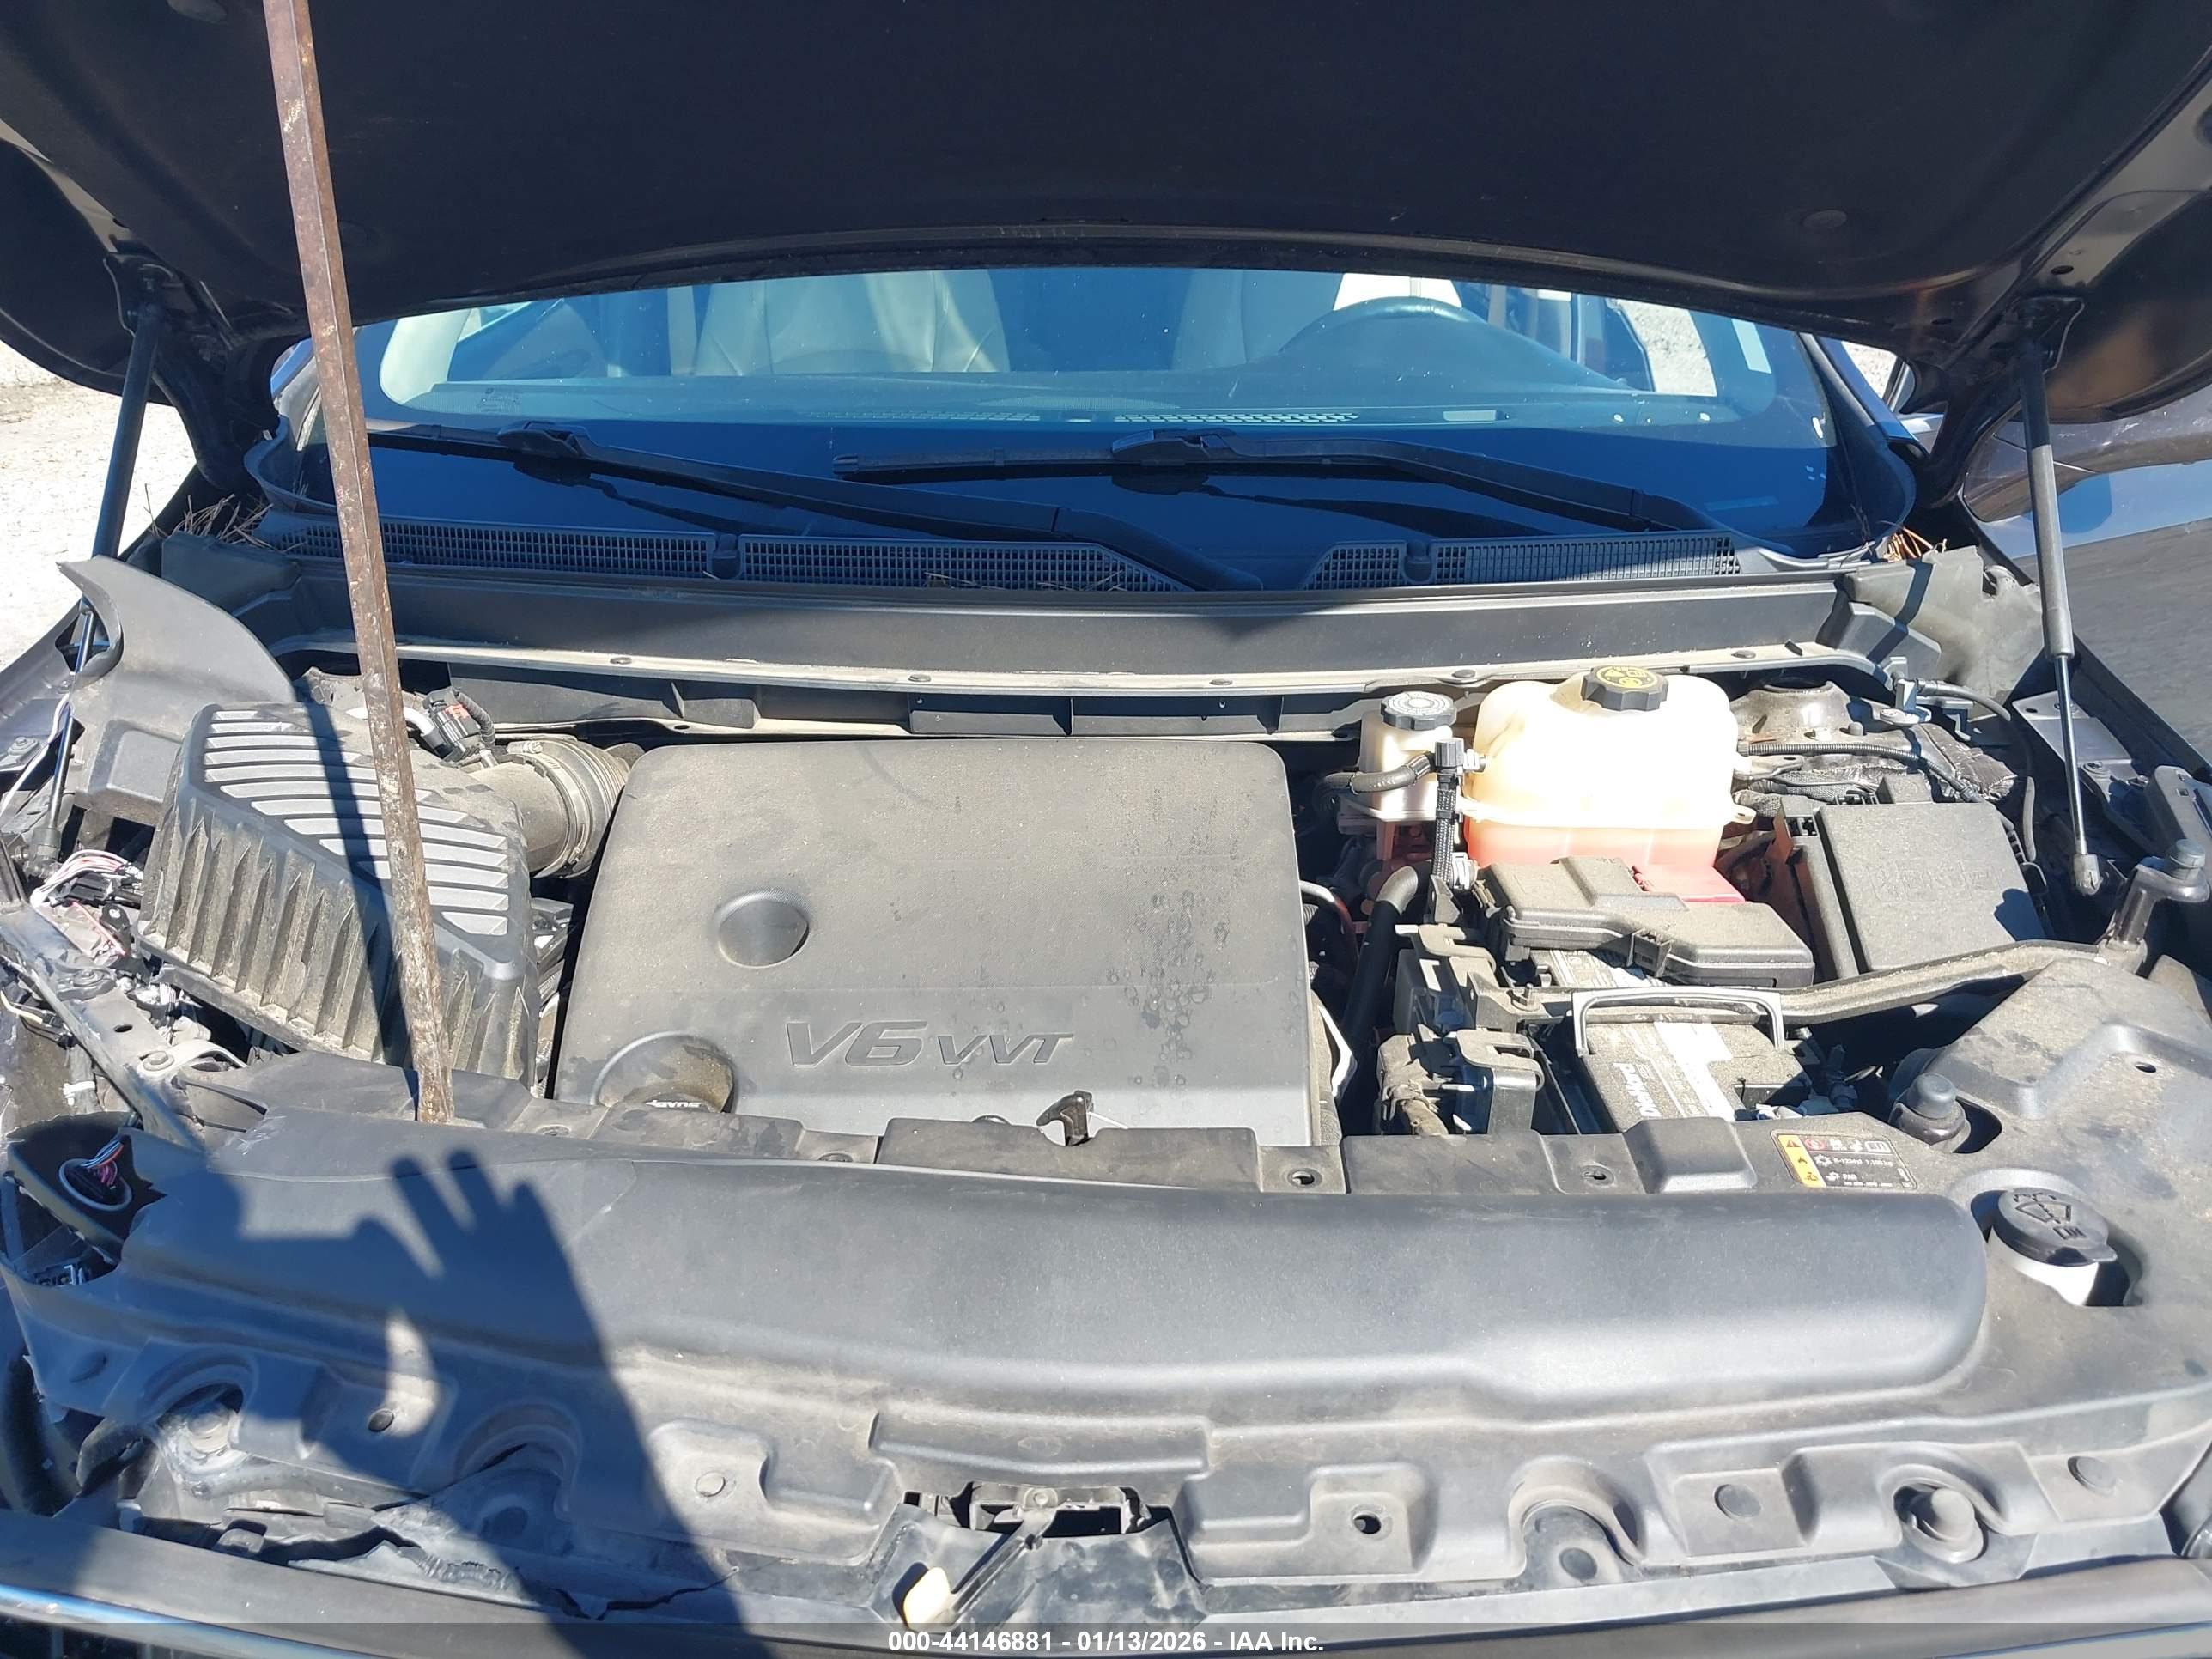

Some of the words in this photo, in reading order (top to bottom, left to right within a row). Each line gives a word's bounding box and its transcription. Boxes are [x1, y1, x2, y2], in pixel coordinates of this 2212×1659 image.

[785, 1020, 928, 1067] V6
[937, 1033, 1074, 1065] VVT
[1613, 1062, 1662, 1117] DieHard
